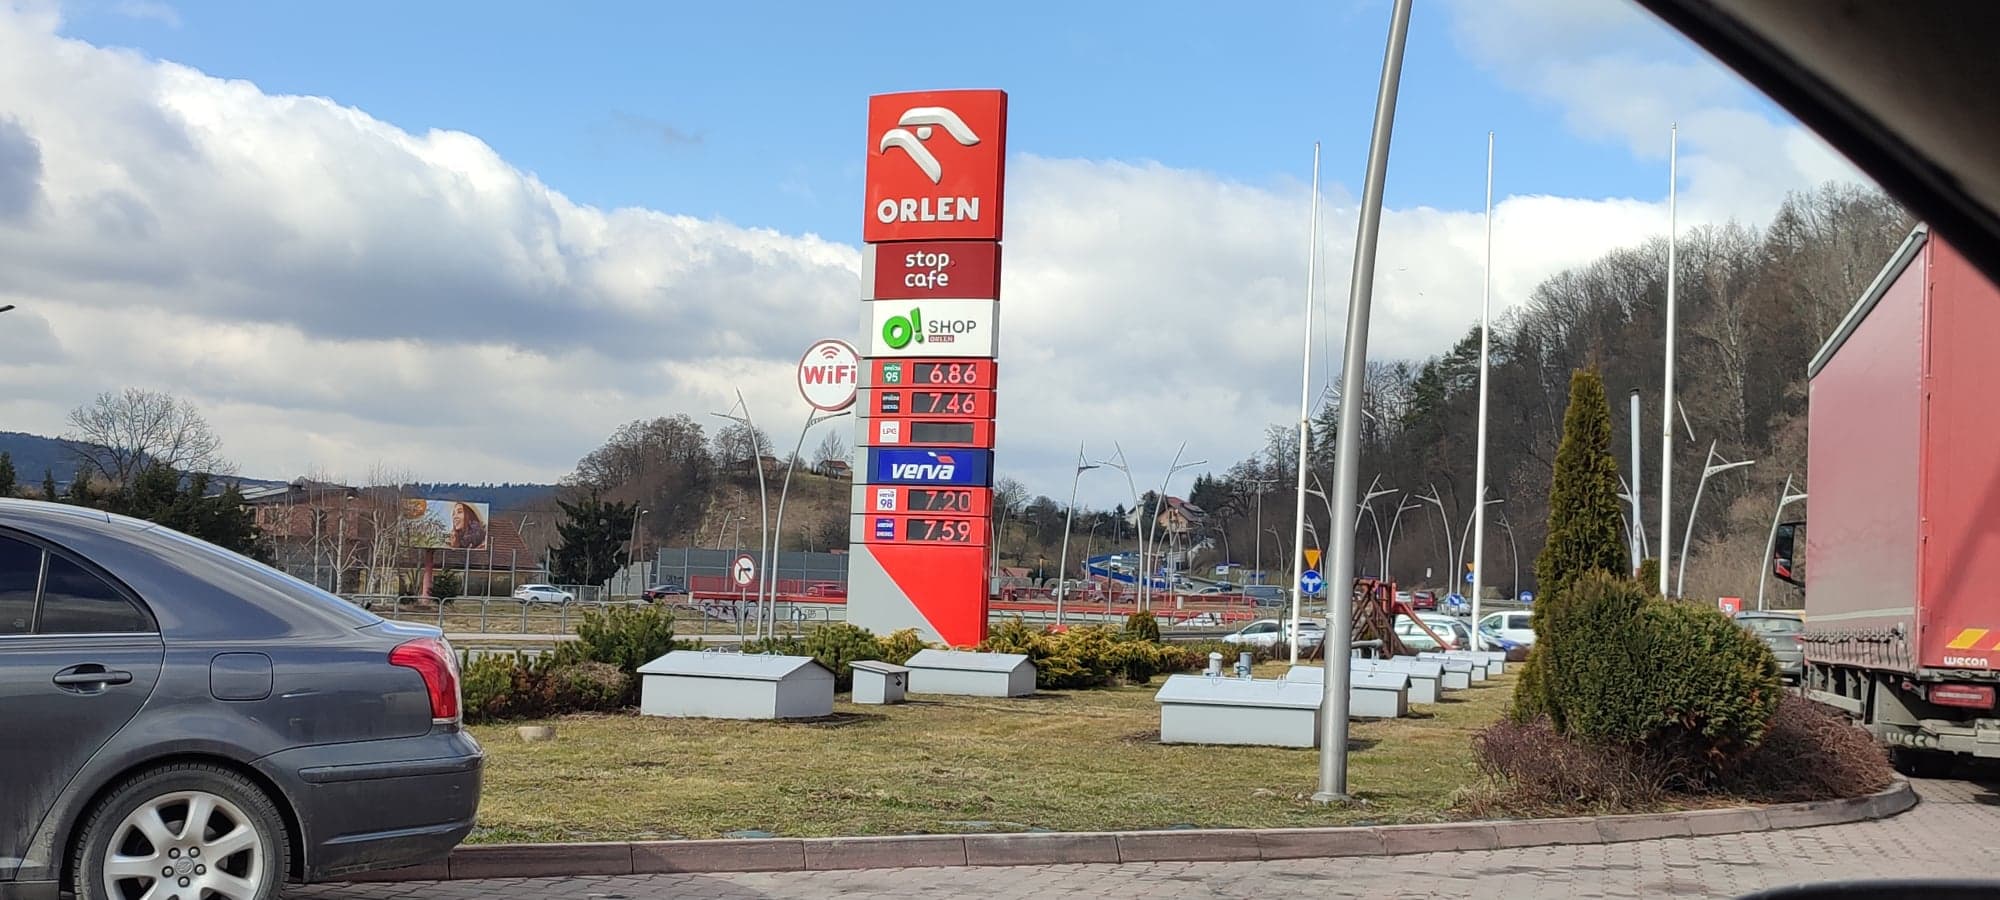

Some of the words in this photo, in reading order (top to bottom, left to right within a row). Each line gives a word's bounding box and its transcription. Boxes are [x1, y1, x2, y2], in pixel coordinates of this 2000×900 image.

[877, 197, 980, 223] ORLEN
[904, 270, 949, 289] cafe
[928, 320, 977, 333] SHOP
[803, 365, 857, 384] WiFi
[885, 371, 899, 382] 95
[930, 364, 976, 383] 6.86
[929, 393, 975, 413] 7.46
[892, 463, 955, 480] verva
[880, 498, 893, 508] 98
[926, 491, 971, 511] 7.20
[924, 520, 971, 541] 7.59
[1943, 656, 1988, 667] wecon
